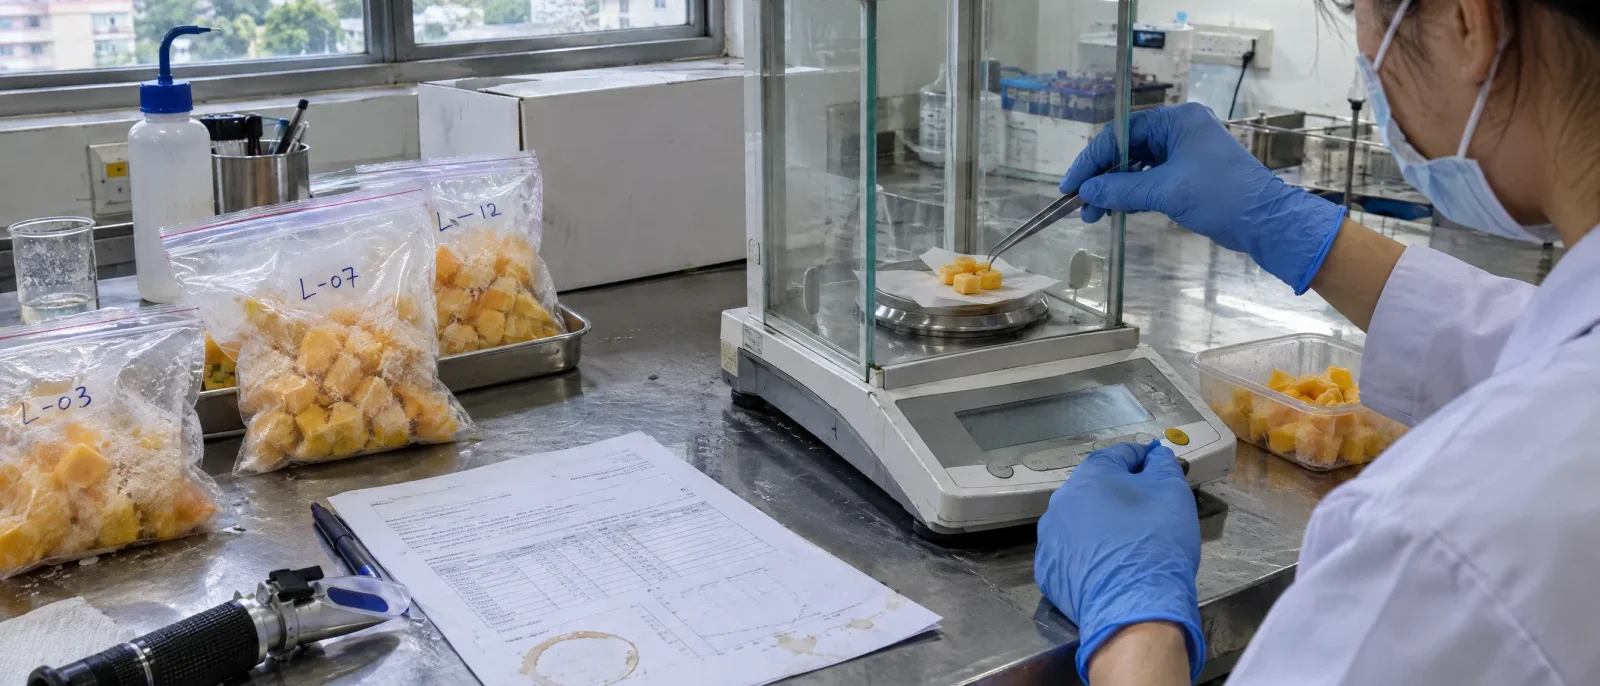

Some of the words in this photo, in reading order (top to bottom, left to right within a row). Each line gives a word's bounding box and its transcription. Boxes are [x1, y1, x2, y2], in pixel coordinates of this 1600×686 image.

[436, 203, 502, 231] L-12
[300, 266, 358, 300] L-07
[21, 386, 92, 425] L-03
